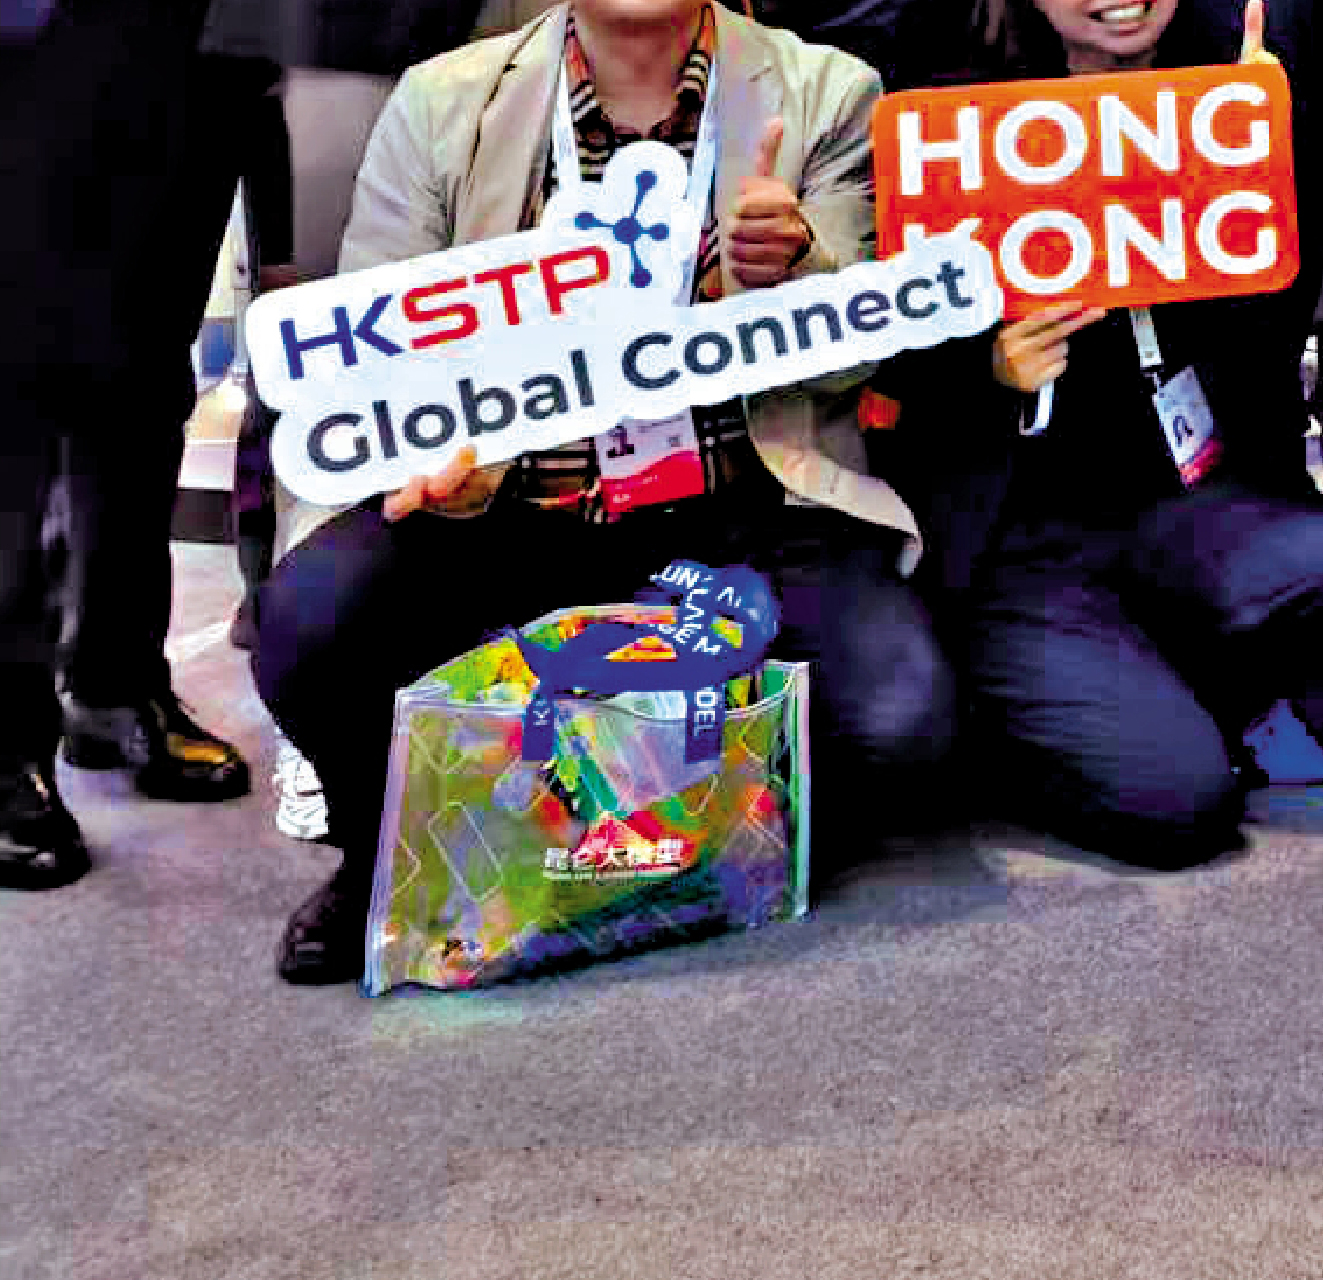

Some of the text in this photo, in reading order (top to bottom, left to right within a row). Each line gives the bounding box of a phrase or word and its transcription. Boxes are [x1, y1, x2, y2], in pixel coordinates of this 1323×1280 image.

[898, 82, 1271, 196] HONG
[903, 190, 1278, 295] ONG
[279, 245, 610, 381] HKSTP
[305, 257, 974, 476] Global Connect
